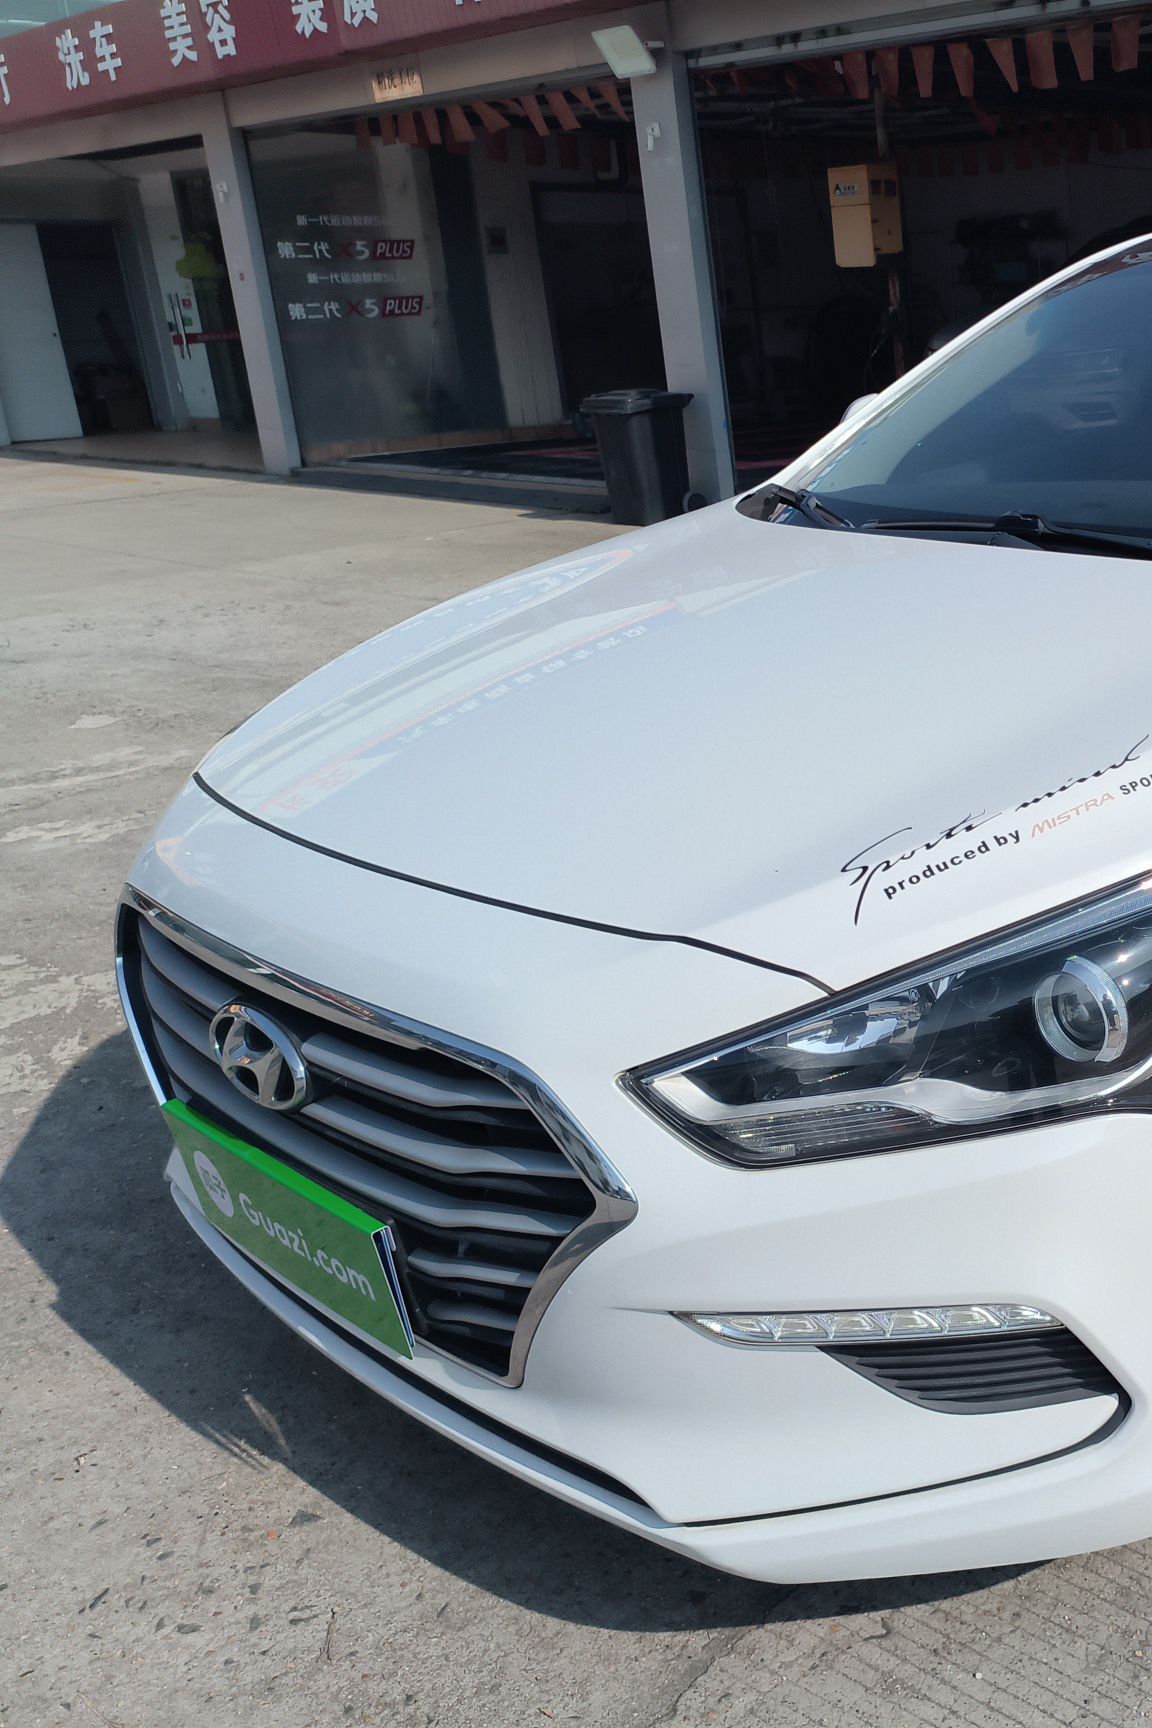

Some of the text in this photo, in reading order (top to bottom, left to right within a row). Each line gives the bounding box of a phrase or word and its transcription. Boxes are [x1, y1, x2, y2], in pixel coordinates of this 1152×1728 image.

[55, 20, 123, 91] 洗车
[160, 0, 238, 68] 美容
[276, 240, 333, 260] 第二代
[376, 241, 412, 258] PLUS
[287, 301, 343, 321] 第二代
[385, 297, 421, 316] PLUS
[882, 839, 991, 900] produced
[993, 826, 1022, 848] by
[1030, 791, 1116, 839] MISTRA
[238, 1192, 377, 1302] Guazi.com
